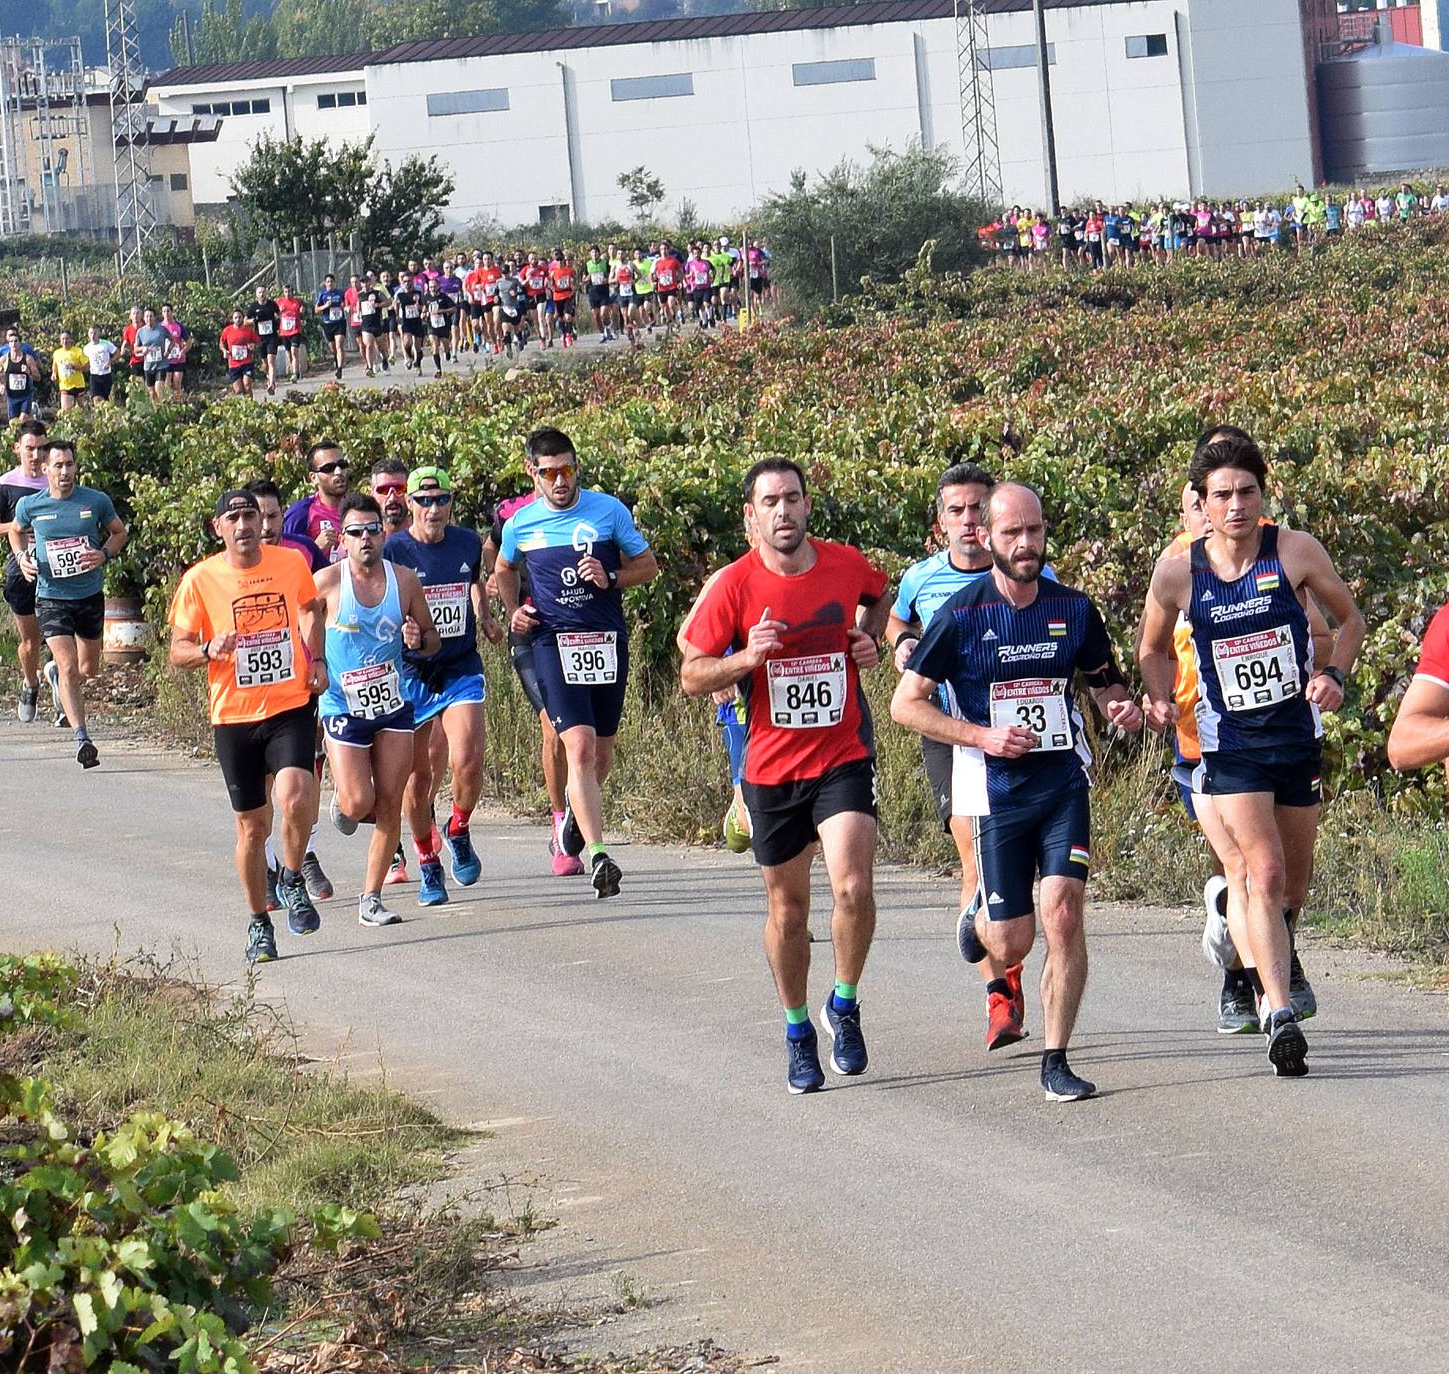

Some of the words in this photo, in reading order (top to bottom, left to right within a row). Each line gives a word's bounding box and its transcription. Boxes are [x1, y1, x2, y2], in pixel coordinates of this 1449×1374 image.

[432, 605, 461, 625] 204
[1210, 595, 1271, 617] RUNNERS
[248, 649, 282, 673] 593
[571, 650, 605, 671] 396
[998, 642, 1058, 656] RUNNERS
[1235, 656, 1283, 691] 694
[357, 682, 391, 707] 595
[787, 681, 832, 710] 846
[1017, 704, 1047, 732] 33
